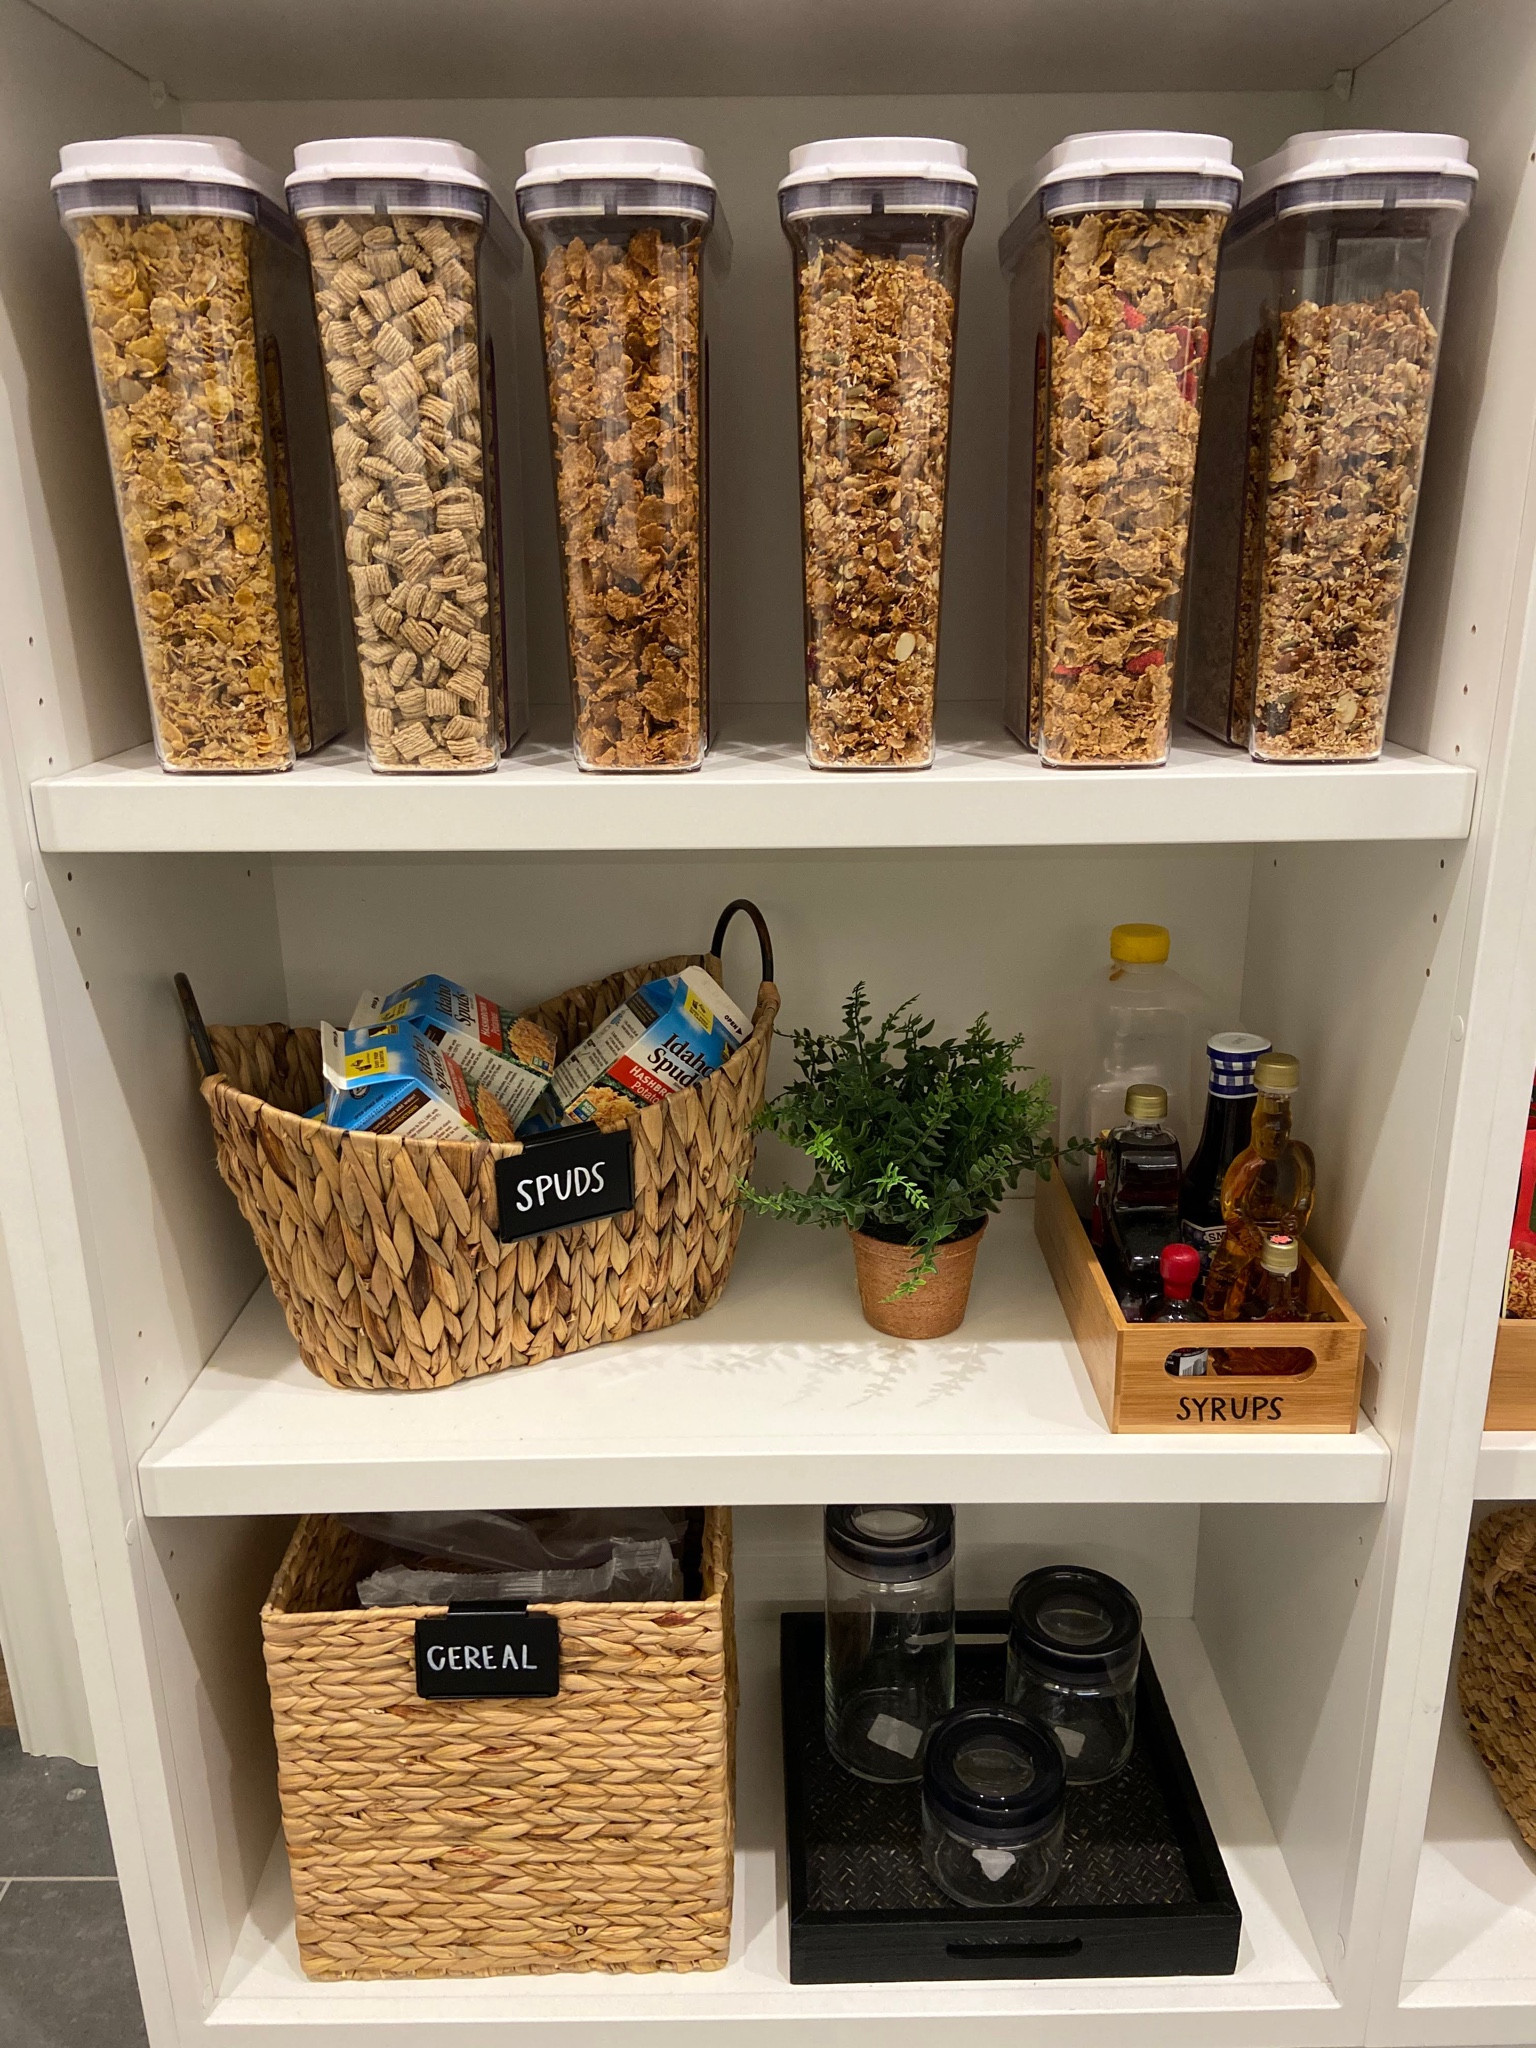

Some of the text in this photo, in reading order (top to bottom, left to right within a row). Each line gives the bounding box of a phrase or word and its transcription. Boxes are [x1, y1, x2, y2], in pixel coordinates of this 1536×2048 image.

[434, 984, 453, 1017] Idaho
[454, 992, 476, 1027] Spuds
[724, 1014, 738, 1029] OPEN
[661, 1032, 716, 1078] Idaho
[631, 1081, 661, 1105] Potato
[516, 1161, 606, 1212] SPUDS
[1176, 1396, 1284, 1422] SYRUPS
